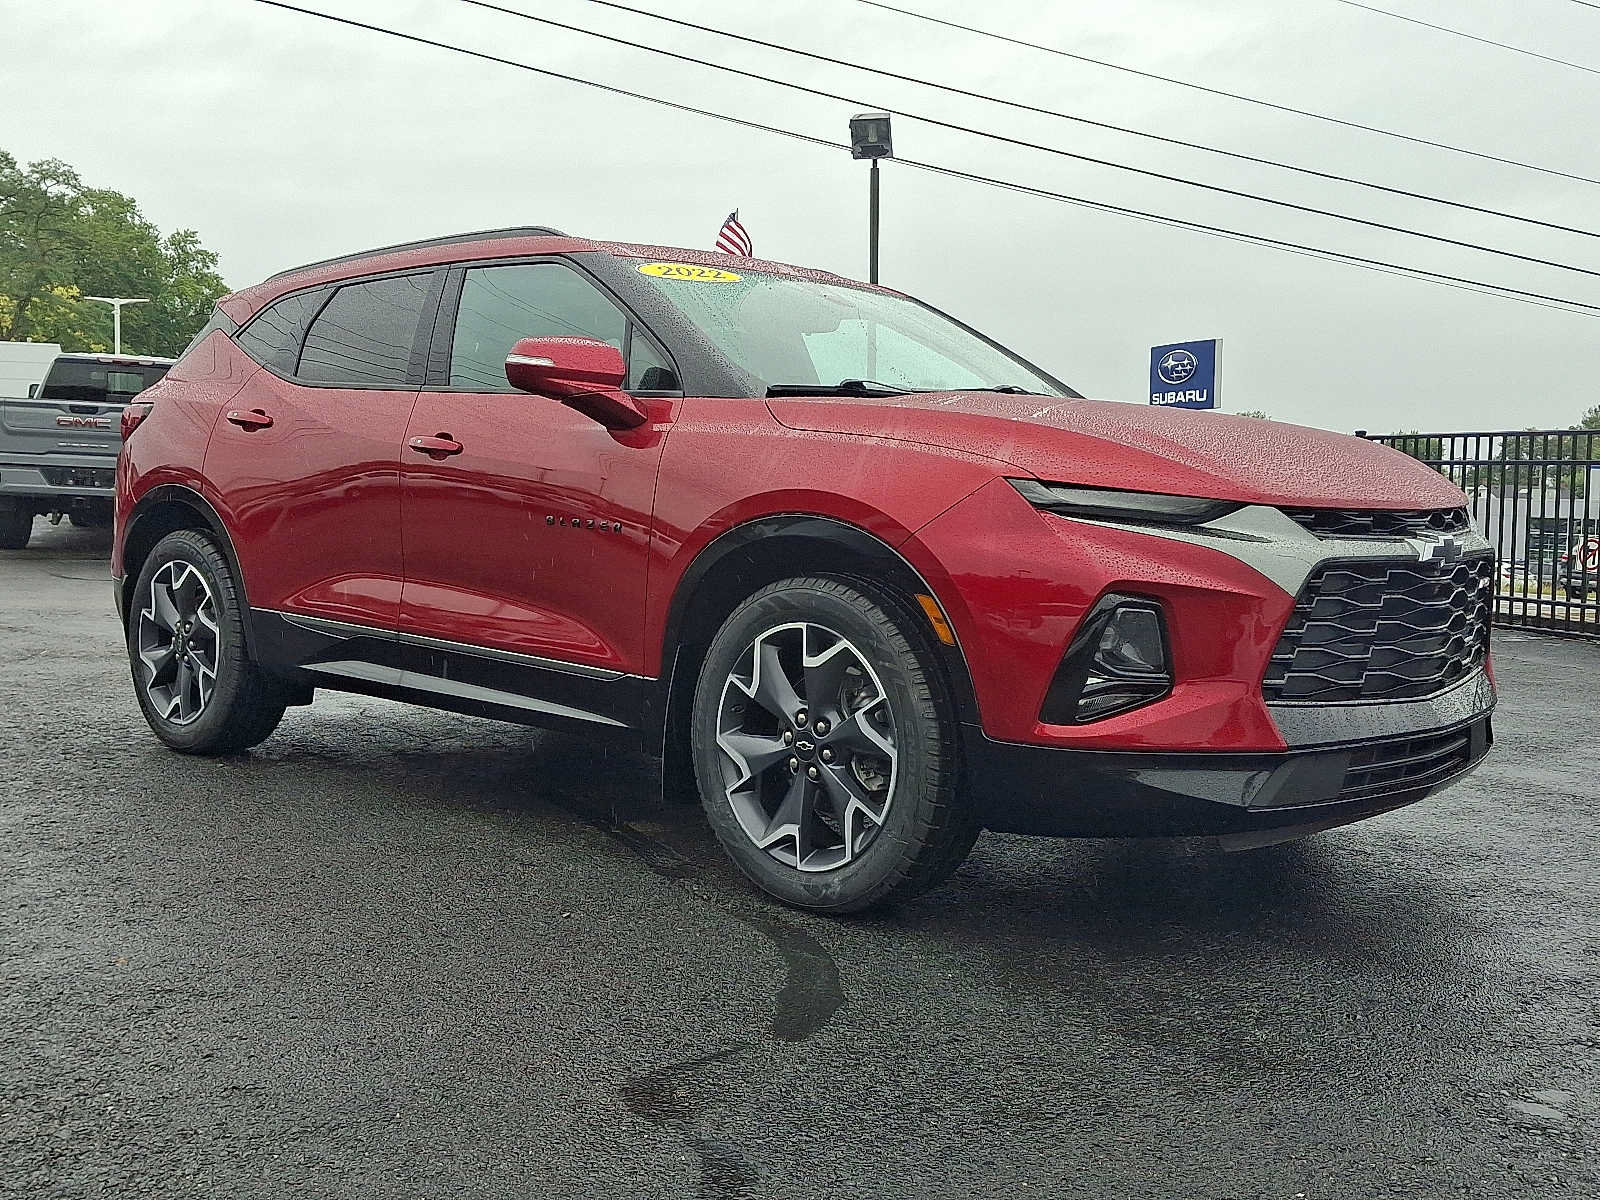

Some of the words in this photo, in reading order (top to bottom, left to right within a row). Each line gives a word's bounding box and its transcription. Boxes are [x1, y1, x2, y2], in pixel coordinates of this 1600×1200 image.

[657, 265, 726, 279] 2022
[1152, 389, 1208, 405] SUBARU
[56, 415, 112, 429] GMC
[545, 515, 623, 533] BLAZER
